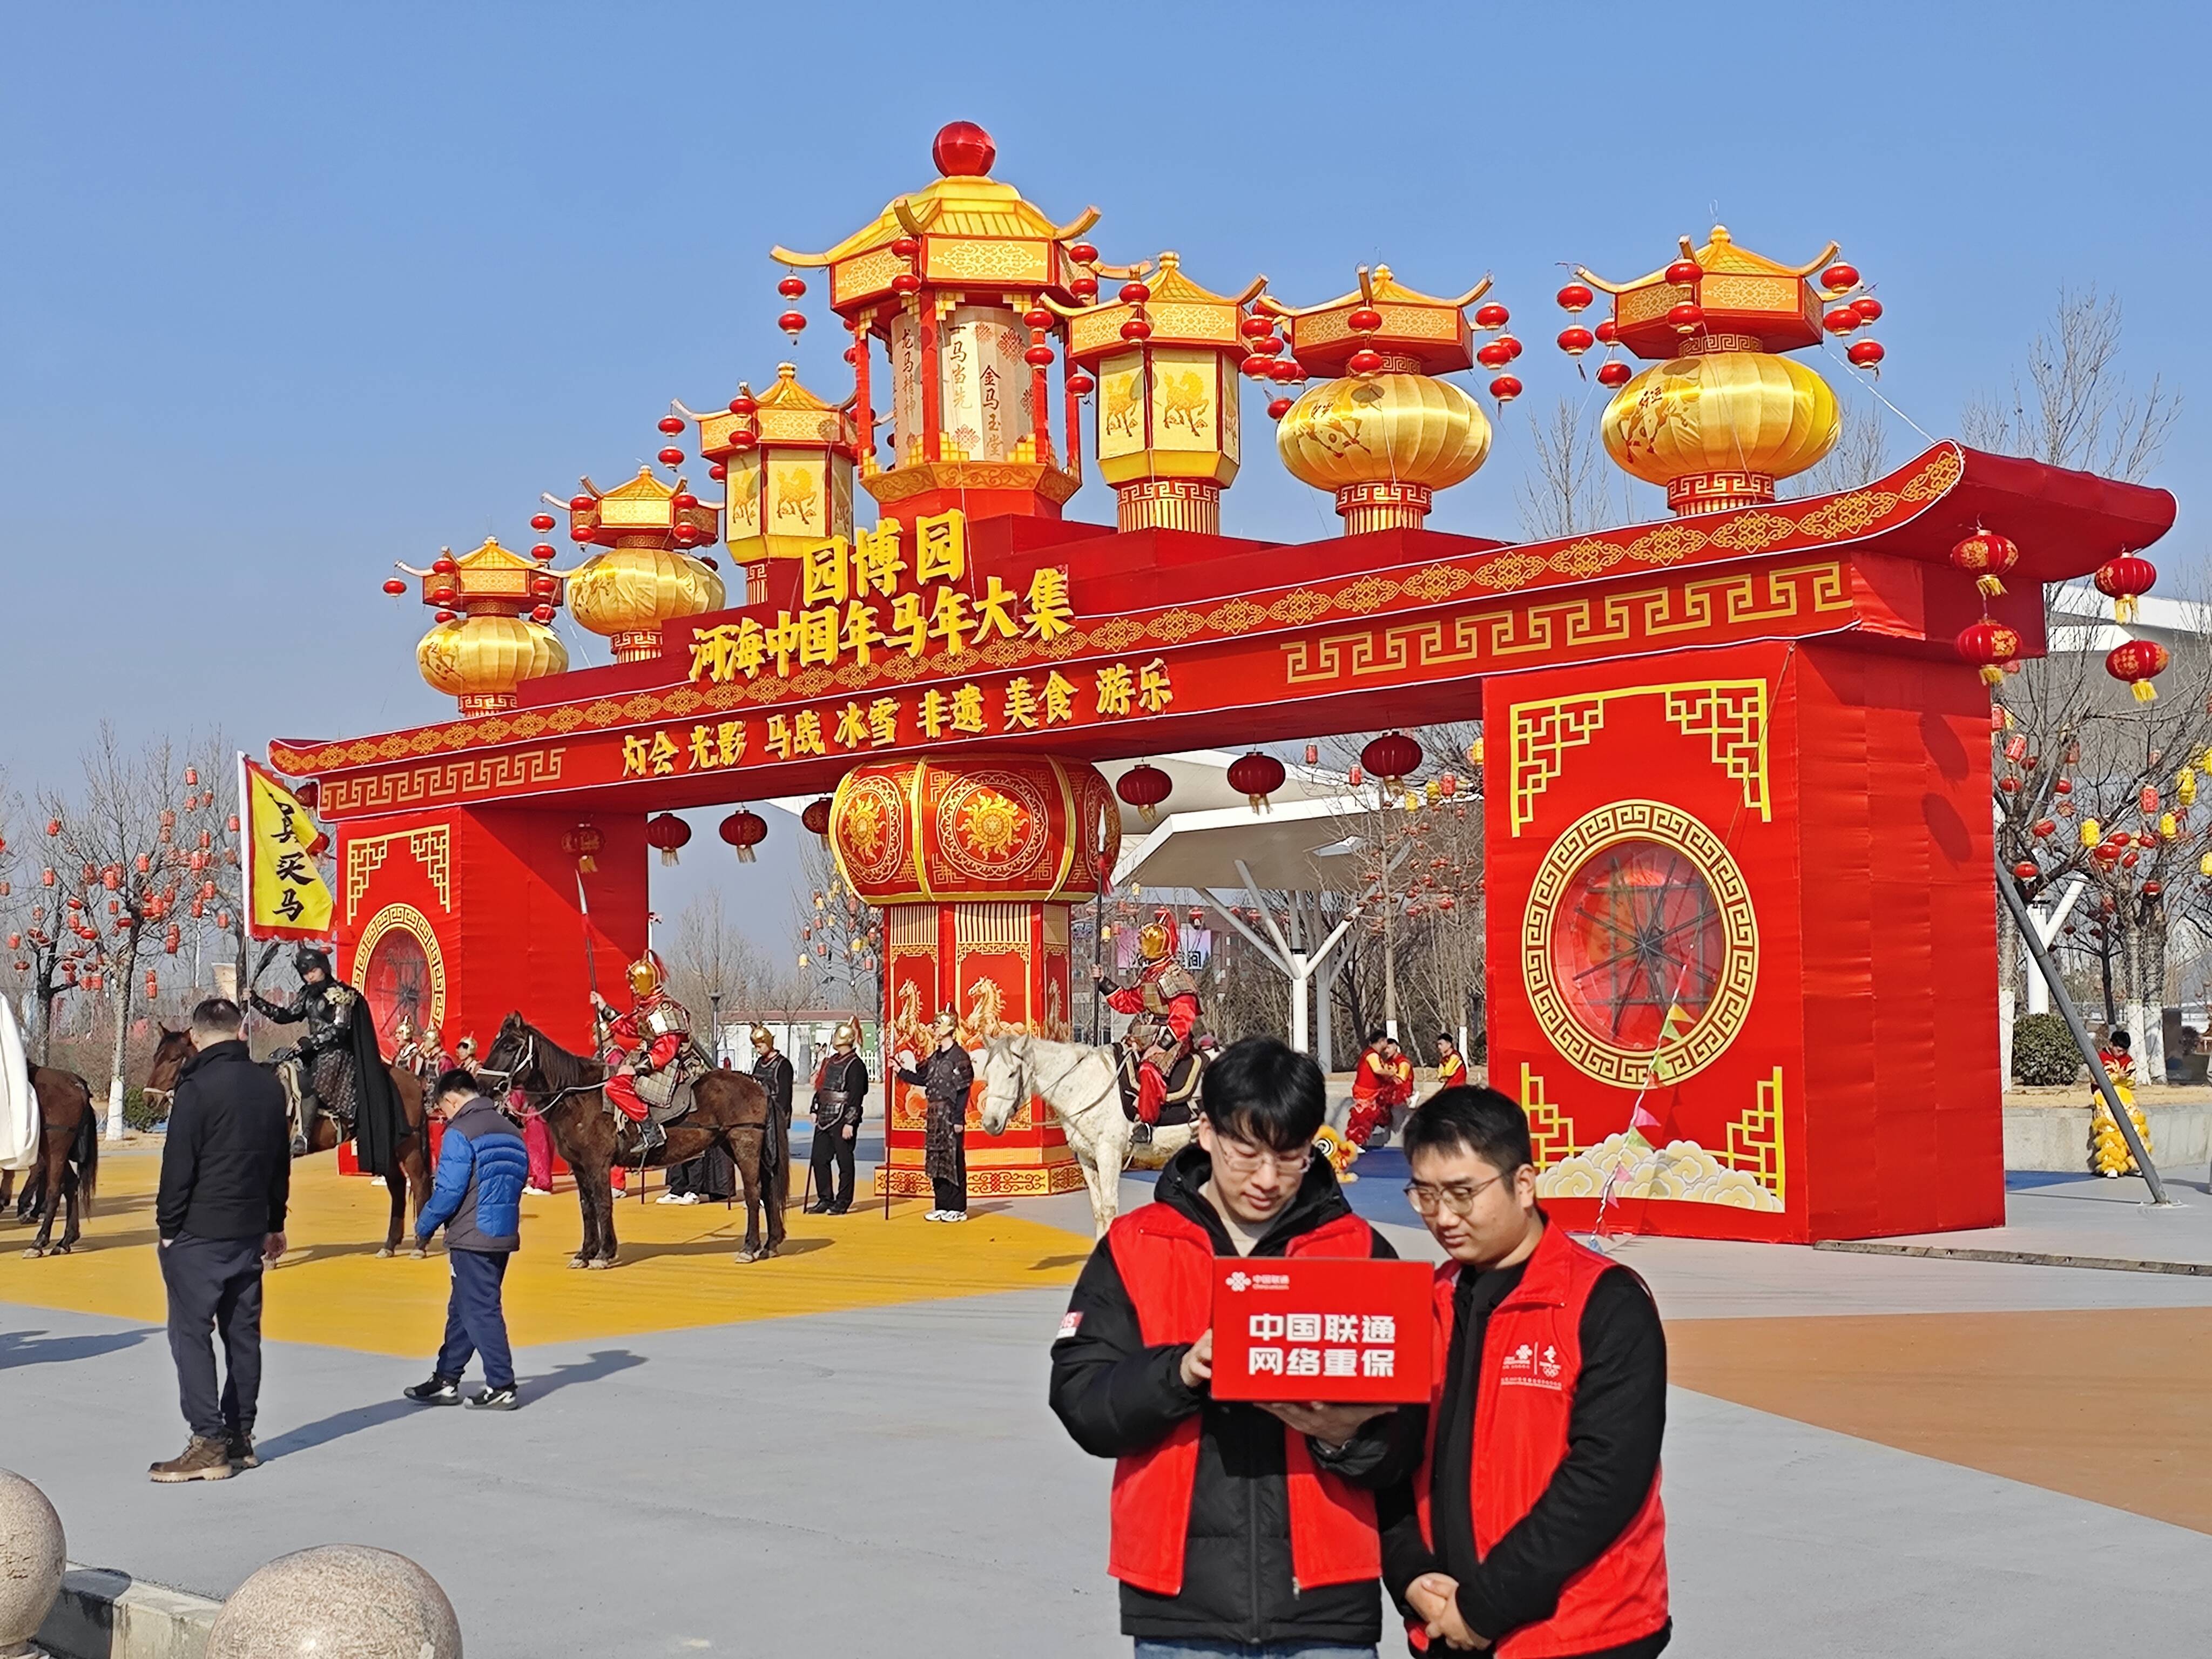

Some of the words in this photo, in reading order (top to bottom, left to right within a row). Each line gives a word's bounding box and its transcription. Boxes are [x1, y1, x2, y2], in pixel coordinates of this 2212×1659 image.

[948, 326, 972, 409] 一马当先
[980, 365, 1004, 456] 金马玉堂
[802, 508, 965, 608] 园博园
[689, 567, 1075, 683] 河海中国年马年大集
[623, 730, 679, 777] 灯会
[687, 720, 747, 770] 光影
[834, 697, 901, 748] 冰雪
[916, 682, 988, 738] 非遗
[1003, 670, 1079, 731] 美食
[1095, 657, 1174, 716] 游乐
[1249, 1313, 1395, 1344] 中国联通
[1249, 1347, 1395, 1377] 网络重保
